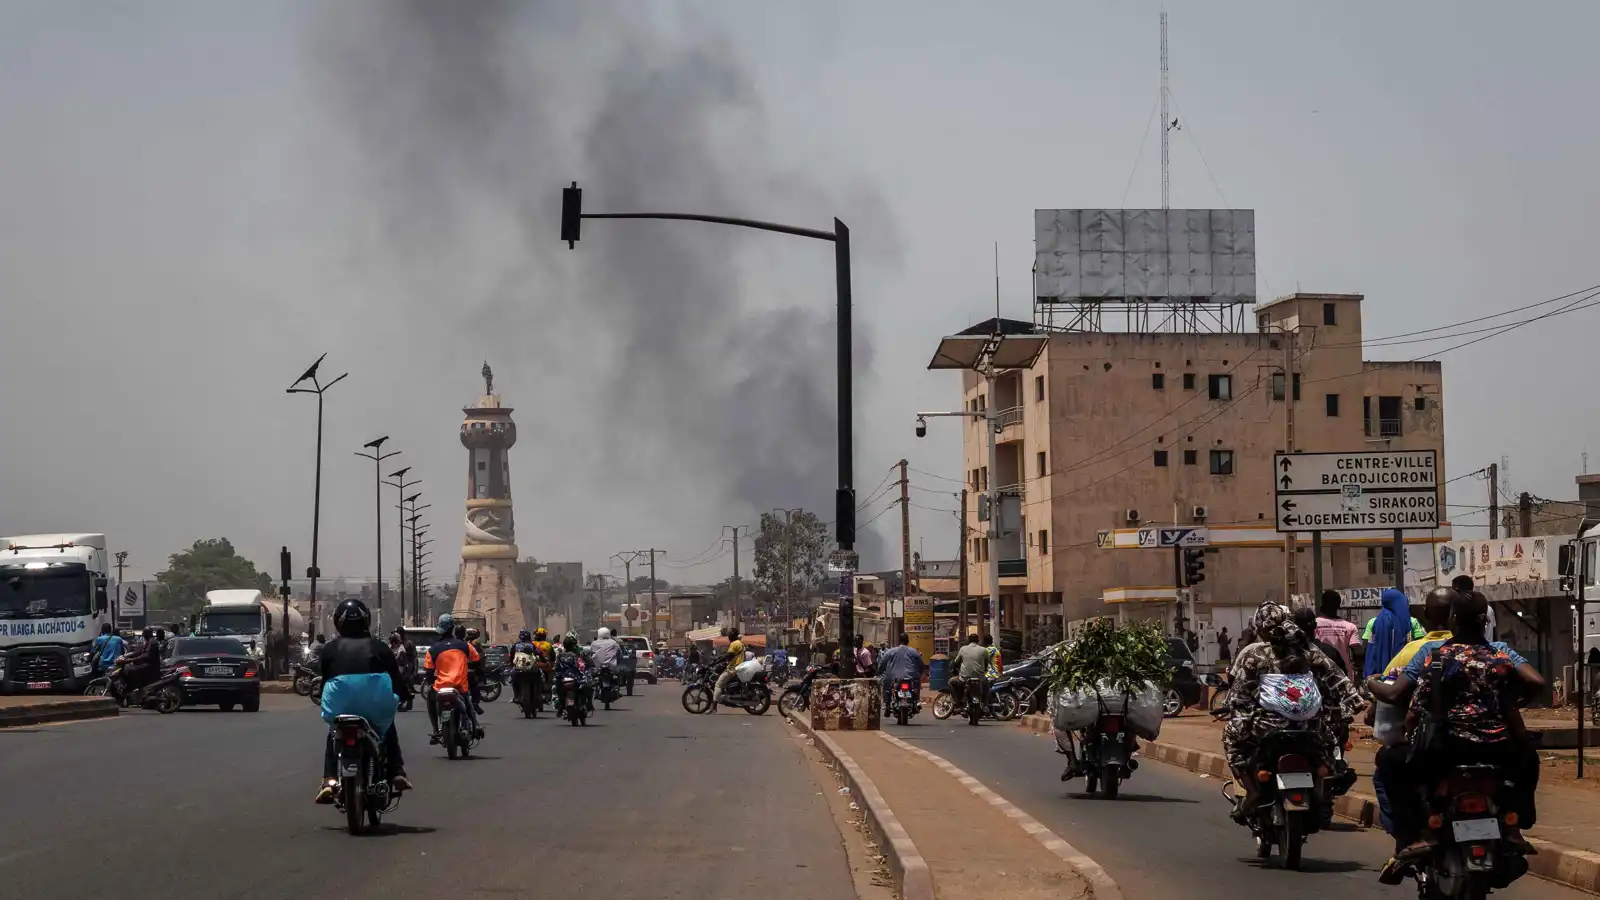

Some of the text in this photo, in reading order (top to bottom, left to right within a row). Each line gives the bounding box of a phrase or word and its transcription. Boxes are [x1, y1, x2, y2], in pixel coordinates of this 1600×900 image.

[1337, 456, 1432, 470] CENTRE-VILLE
[1322, 472, 1433, 485] BACODJICORONI
[1369, 497, 1434, 509] SIRAKORO
[1298, 511, 1436, 526] LOGEMENTS SOCIAUX
[10, 623, 35, 636] MAIGA
[37, 620, 77, 635] AICHATOU
[77, 620, 86, 630] 4
